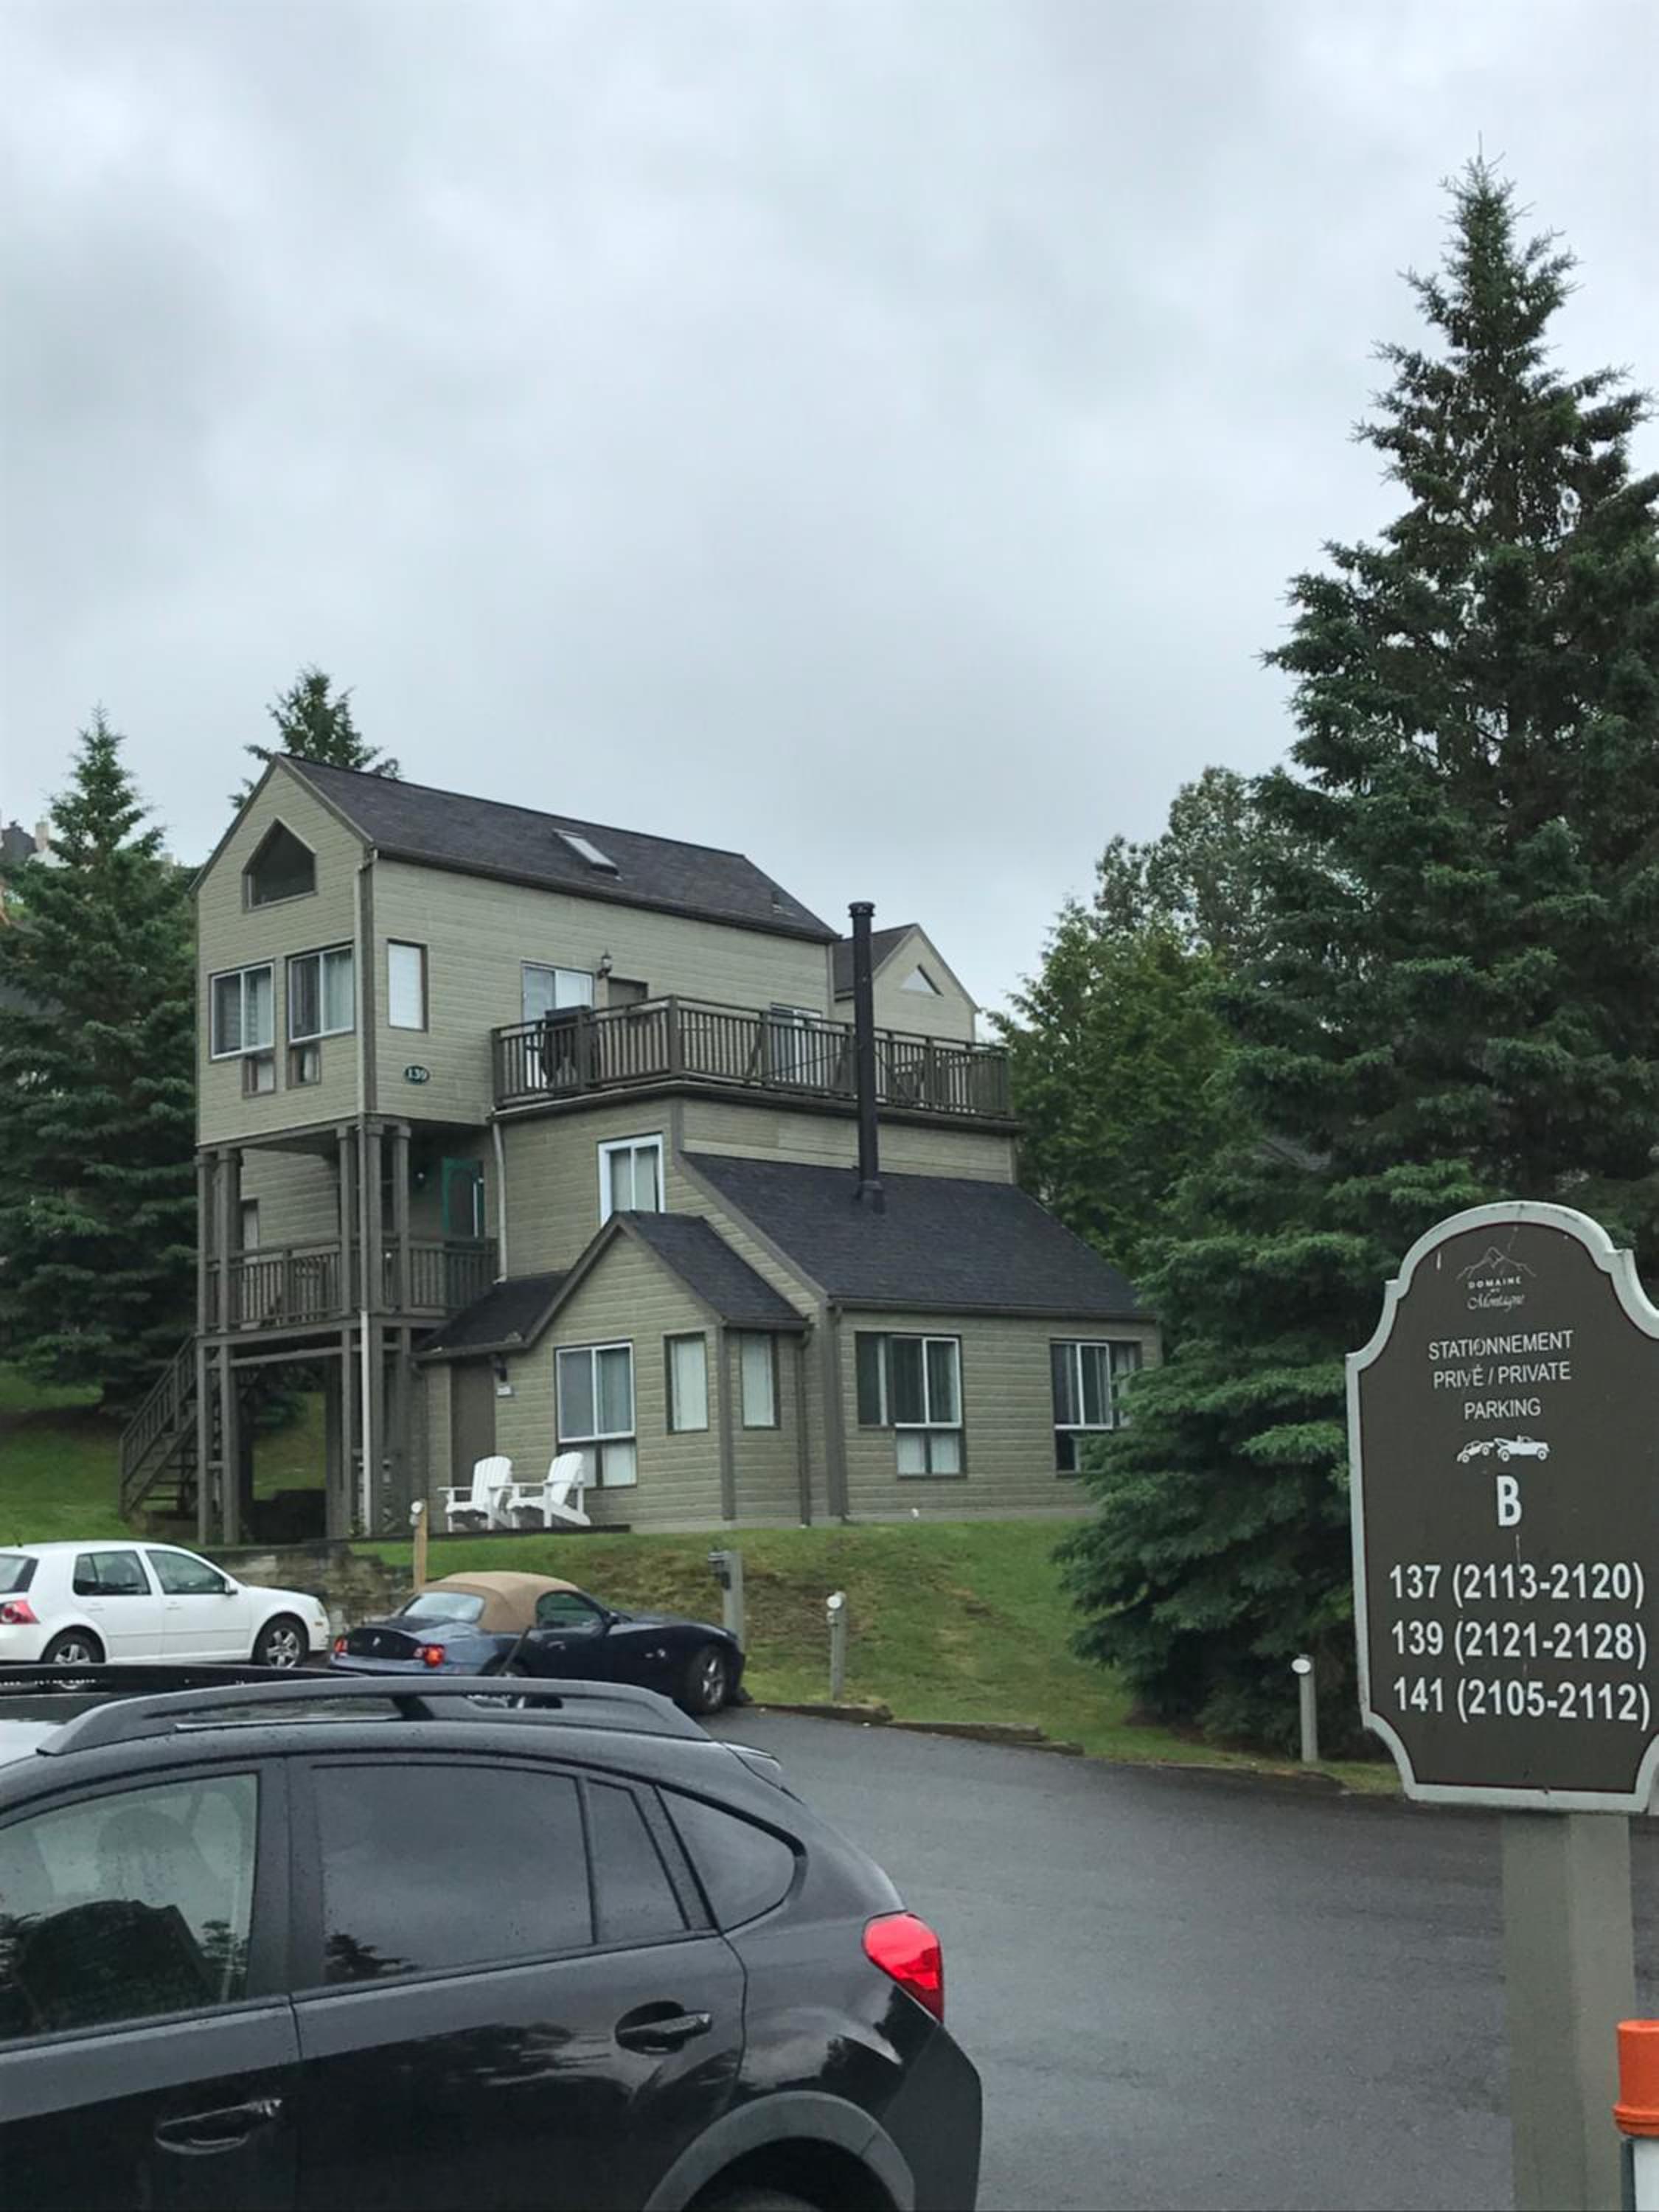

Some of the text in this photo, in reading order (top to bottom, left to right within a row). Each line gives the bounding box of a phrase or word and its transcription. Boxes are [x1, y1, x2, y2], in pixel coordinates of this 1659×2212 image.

[1468, 1276, 1521, 1289] DOMAINE
[1429, 1330, 1573, 1360] STATIONNEMENT
[1433, 1363, 1483, 1388] PRIVÉ
[1498, 1362, 1571, 1383] PRIVATE
[1464, 1397, 1541, 1420] PARKING
[1496, 1475, 1522, 1526] B
[1389, 1562, 1644, 1610] 137 (2113-2120)
[1391, 1620, 1646, 1670] 139 (2121-2128)
[1394, 1676, 1650, 1731] 141 (2105-2112)
